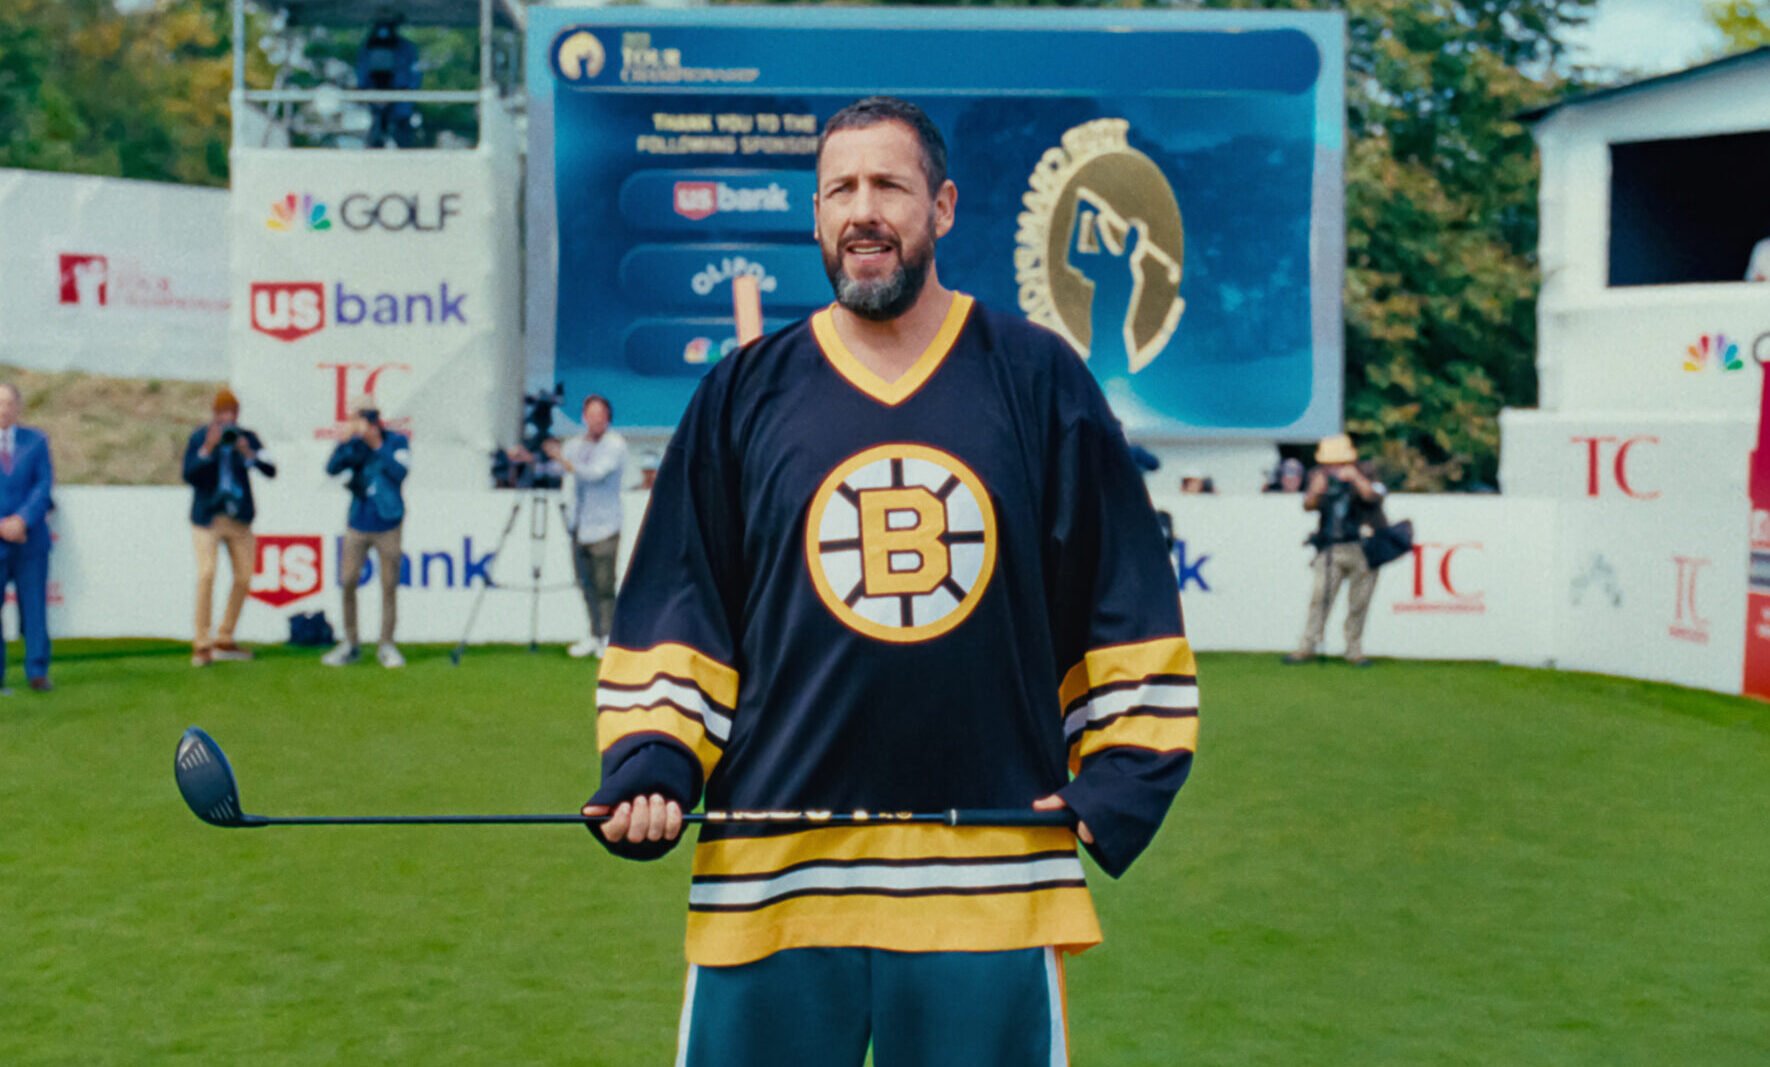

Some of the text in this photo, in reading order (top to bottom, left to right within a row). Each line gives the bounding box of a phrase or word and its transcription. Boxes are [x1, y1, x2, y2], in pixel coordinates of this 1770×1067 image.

[340, 192, 462, 231] GOLF
[334, 281, 468, 325] bank
[1570, 435, 1662, 499] TC
[856, 484, 952, 599] B
[1411, 541, 1485, 600] TC
